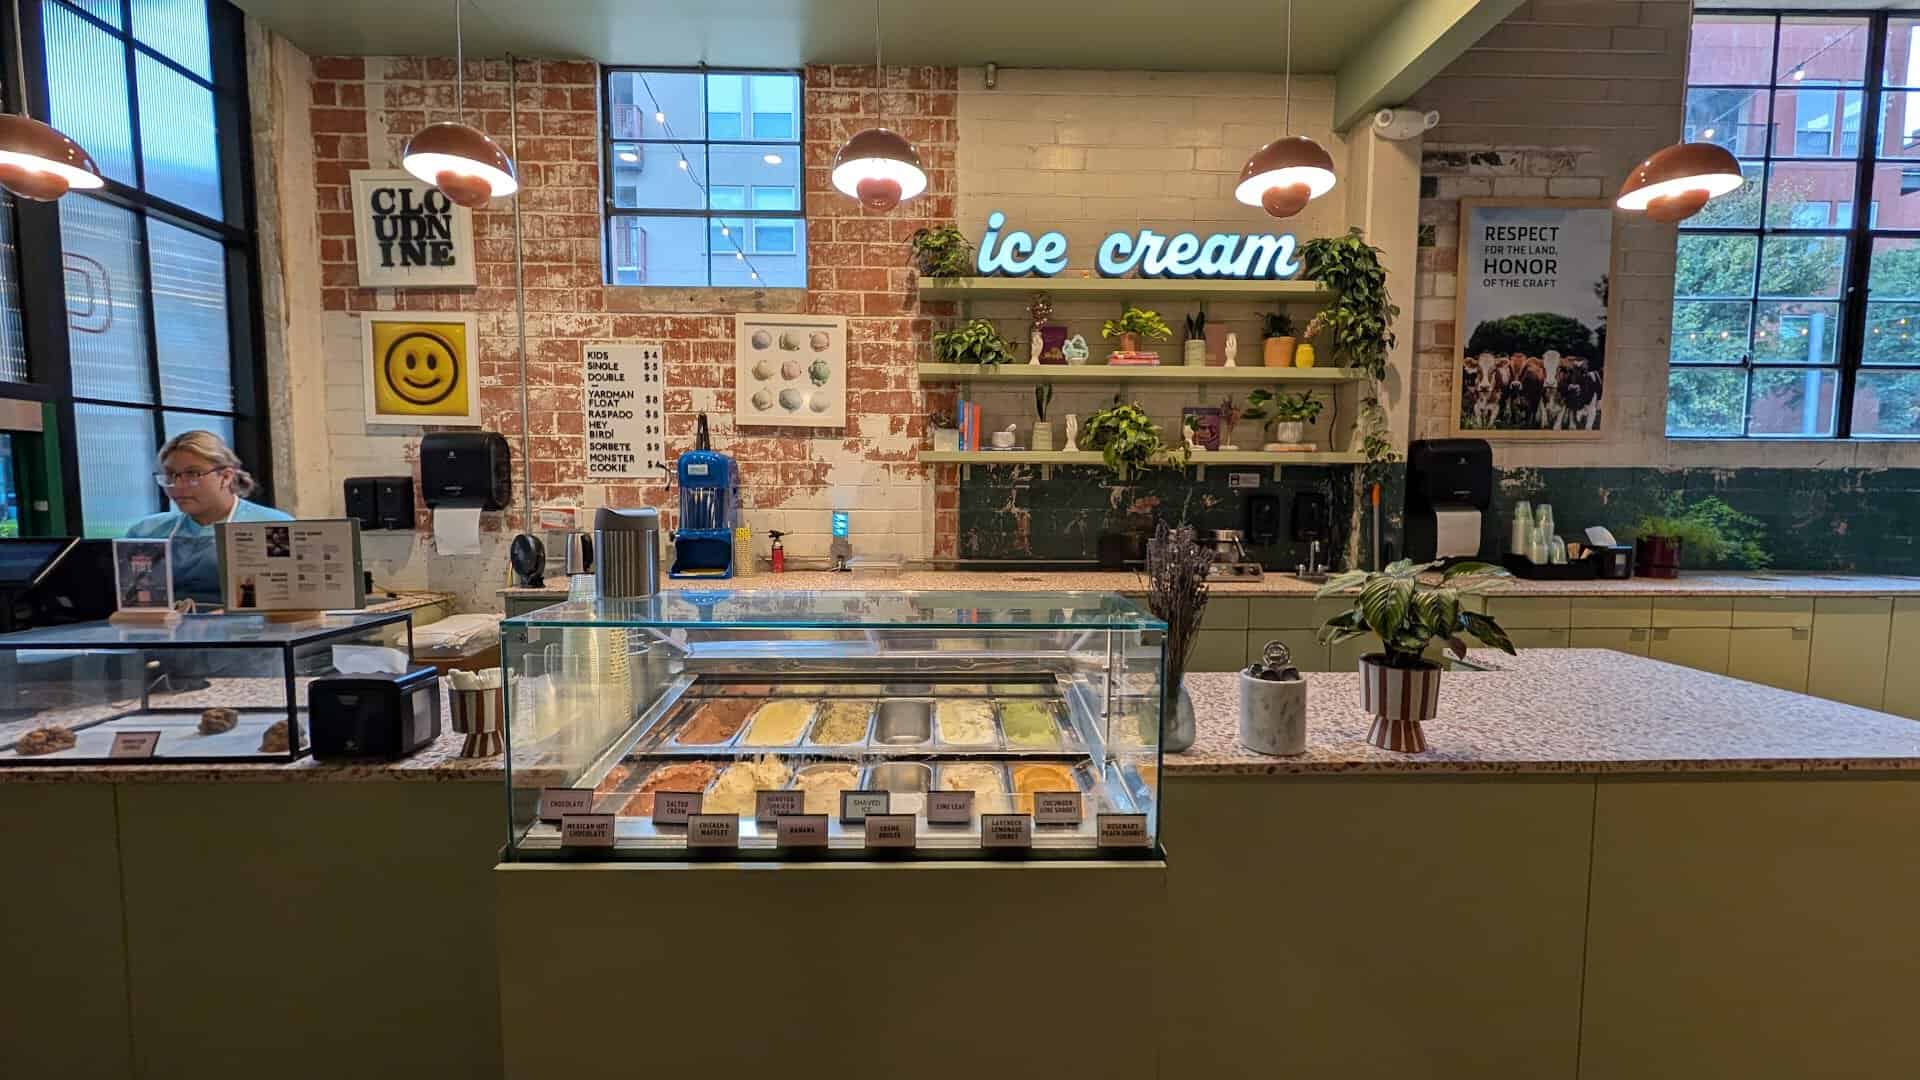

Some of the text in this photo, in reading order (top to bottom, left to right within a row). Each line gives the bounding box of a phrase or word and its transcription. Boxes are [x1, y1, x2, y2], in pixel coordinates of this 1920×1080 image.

[371, 187, 451, 214] CLO
[372, 214, 452, 241] UDN
[1485, 226, 1560, 241] RESPECT
[976, 211, 1300, 277] ice cream
[378, 240, 455, 267] INE
[1485, 246, 1558, 256] FOR THE LAND,
[1484, 258, 1557, 275] HONOR
[1483, 279, 1556, 288] OF THE CRAFT
[587, 352, 609, 360] KIDS
[587, 362, 619, 371] SINGLE
[588, 373, 625, 382] DOUBLE
[588, 390, 634, 399] YARDMAN
[589, 399, 620, 408] FLOAT
[588, 410, 634, 419] RASPADO
[589, 421, 608, 430] HEY
[590, 442, 632, 451] SORBETE
[590, 454, 635, 463] MONSTER
[590, 463, 628, 473] COOKIE
